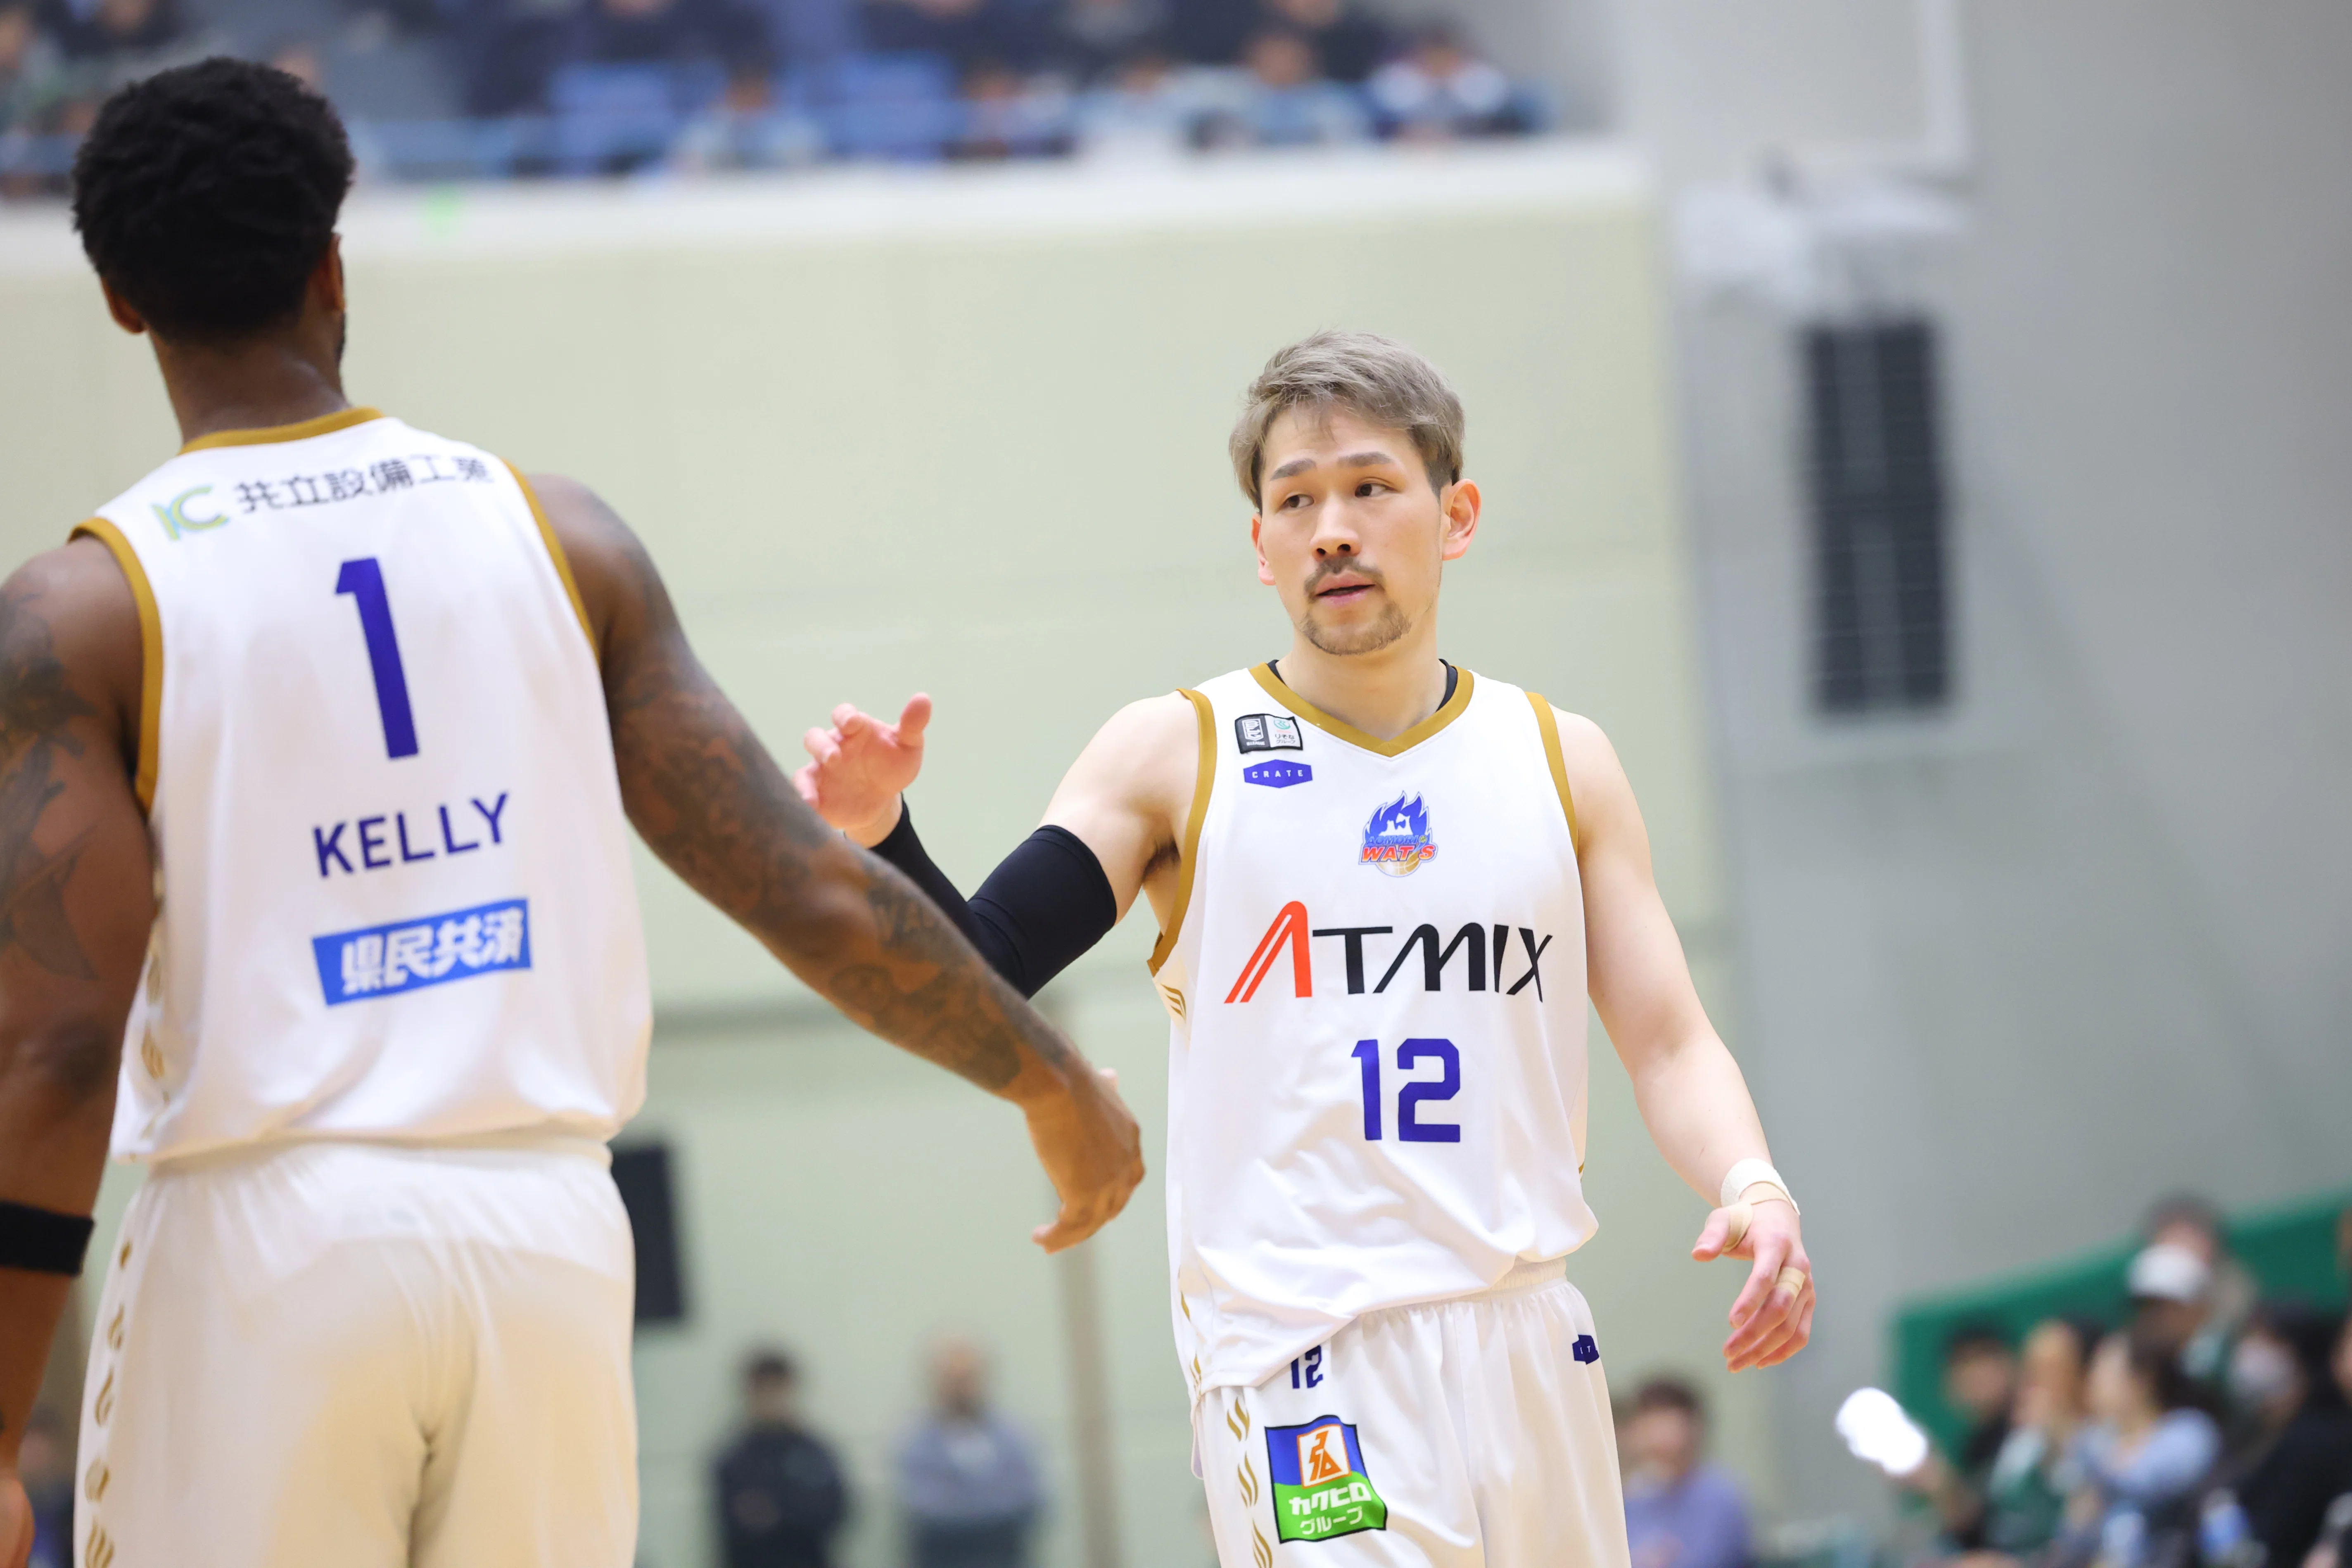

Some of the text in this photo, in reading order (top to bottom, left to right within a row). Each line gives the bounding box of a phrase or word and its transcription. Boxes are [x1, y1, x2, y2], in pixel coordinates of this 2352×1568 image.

[336, 556, 418, 760] 1
[1252, 769, 1303, 778] CRATE
[312, 791, 508, 878] KELLY
[1224, 901, 1553, 1003] ATMIX
[1351, 1038, 1461, 1142] 12
[1291, 1345, 1324, 1389] 12
[1289, 1482, 1372, 1516] カクヒロ
[1299, 1506, 1363, 1535] グループ
